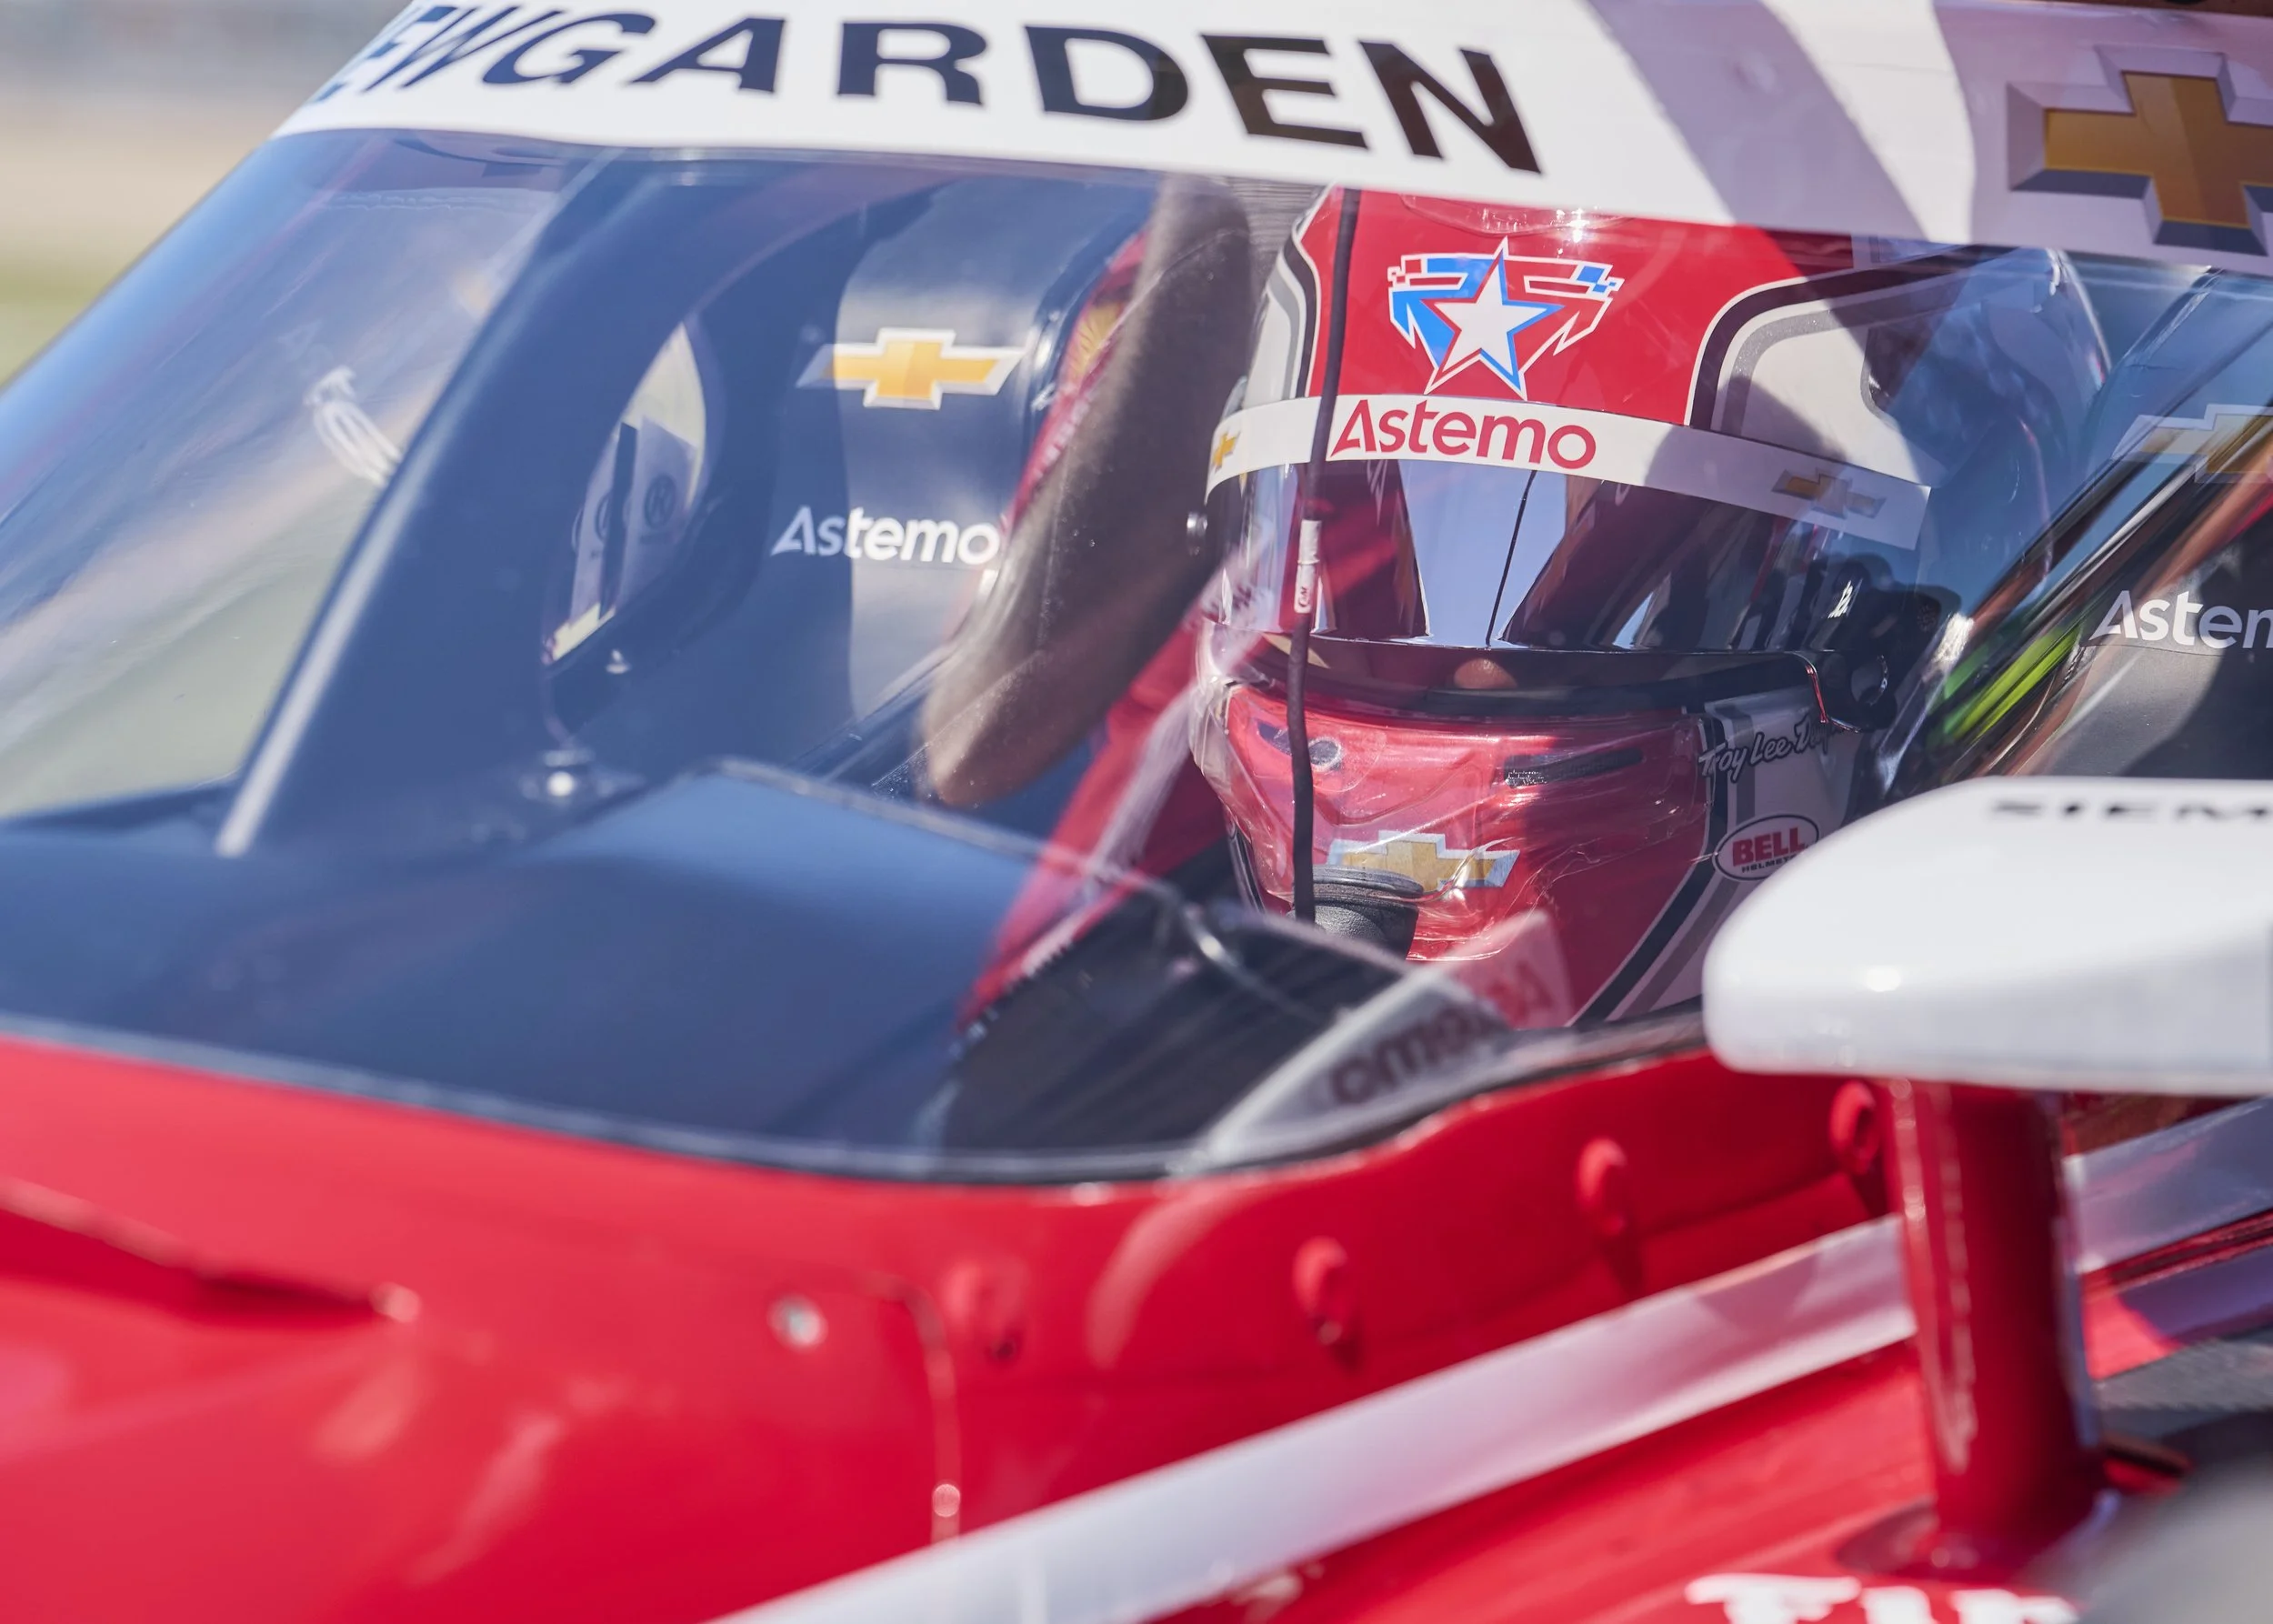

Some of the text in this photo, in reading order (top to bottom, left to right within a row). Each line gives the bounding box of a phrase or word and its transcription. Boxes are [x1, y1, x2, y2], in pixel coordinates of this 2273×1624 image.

[1330, 399, 1597, 469] Astemo
[770, 506, 999, 565] Astemo
[1697, 740, 1749, 784] Troy
[1748, 731, 1793, 767] Lee
[1732, 827, 1806, 867] BELL
